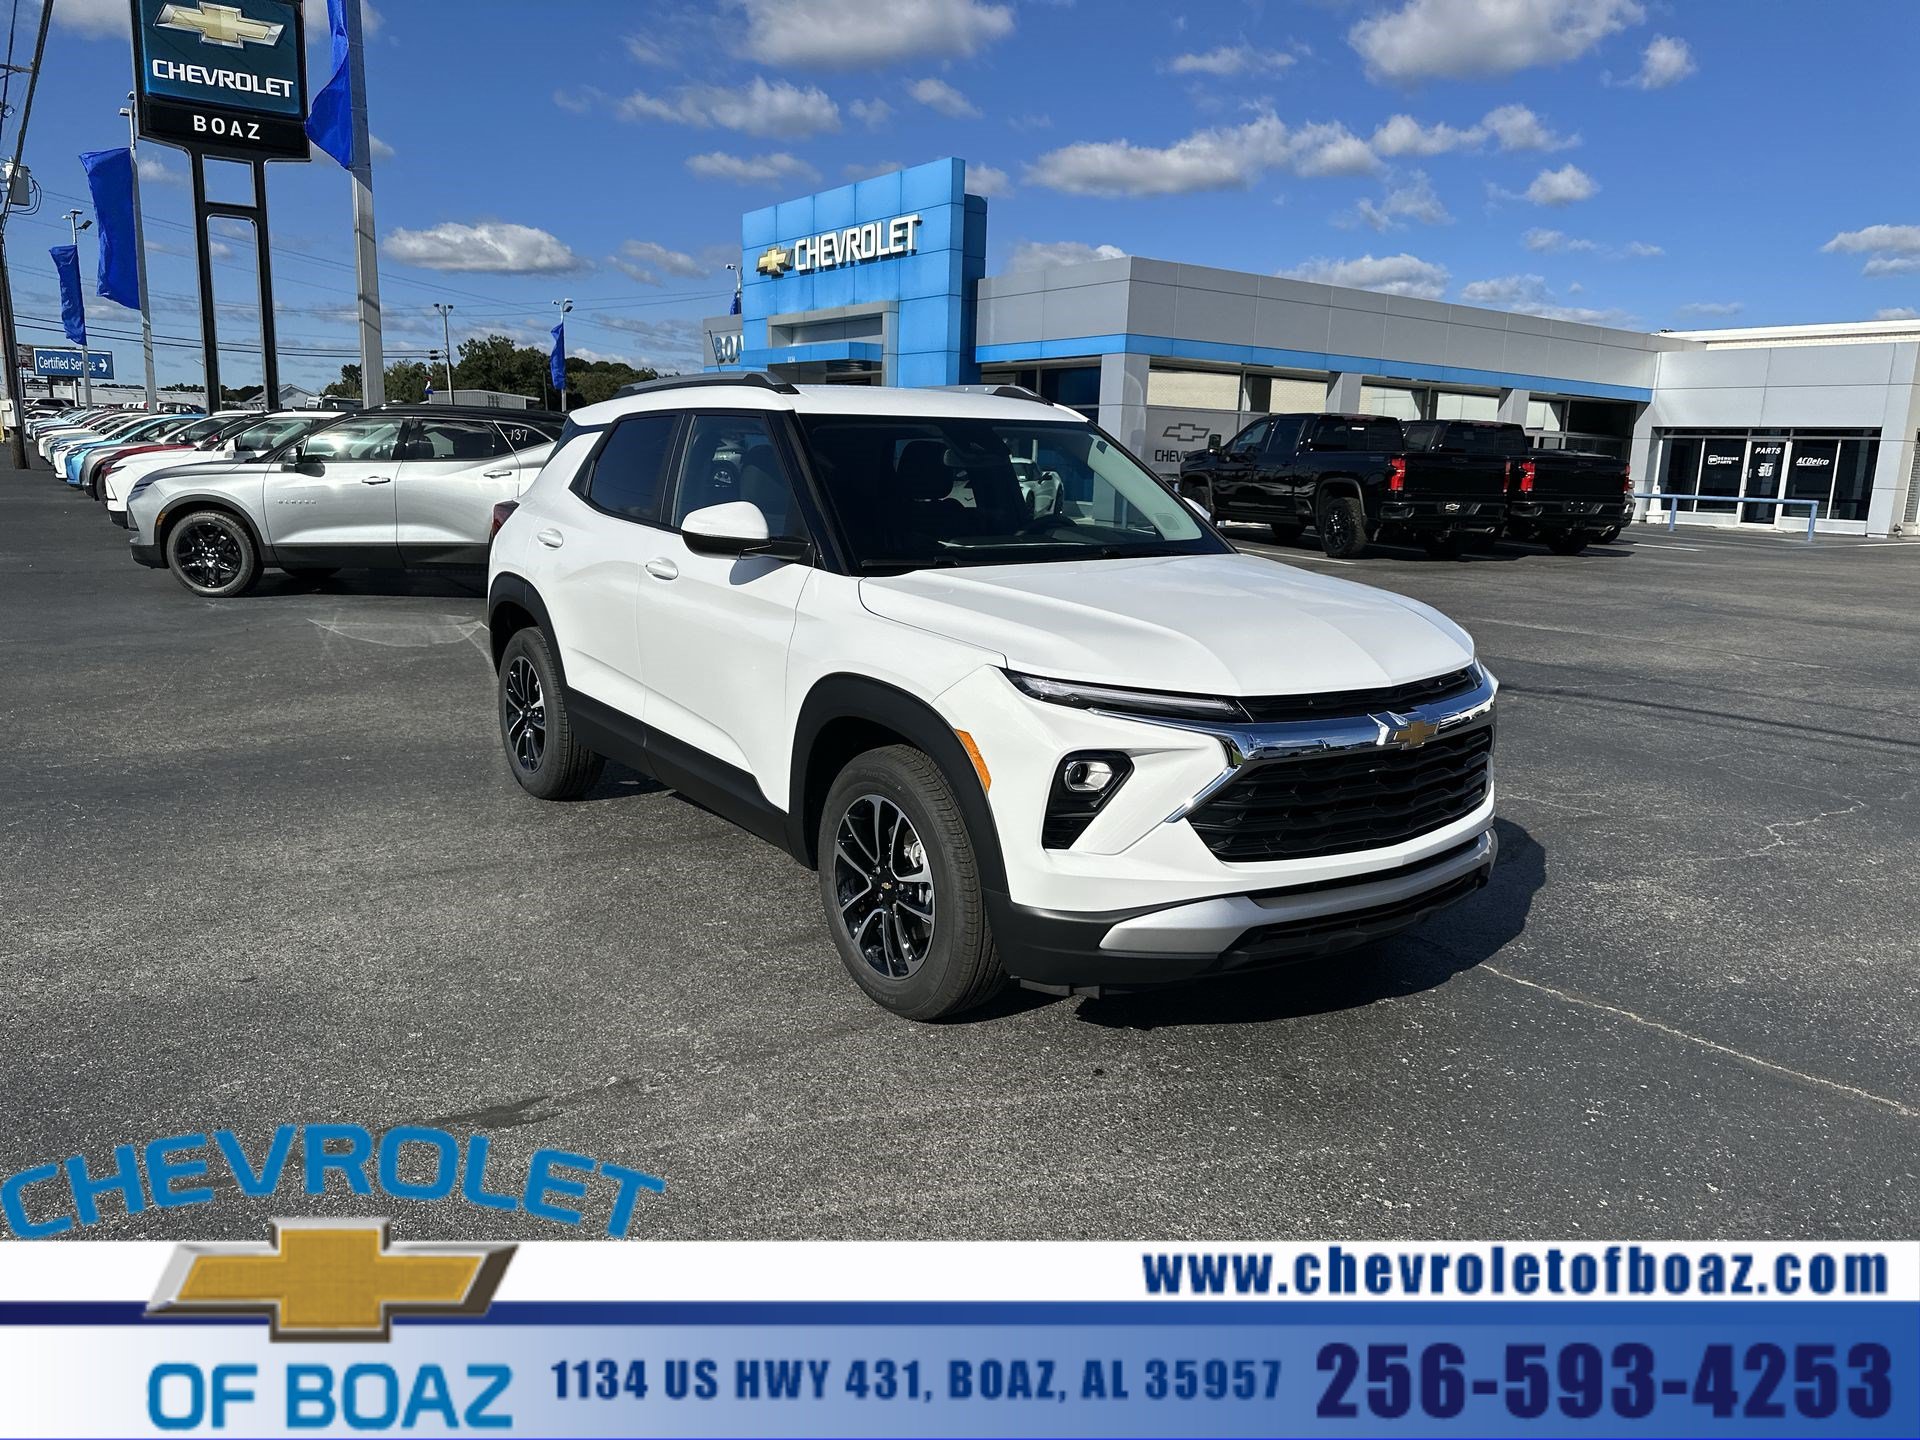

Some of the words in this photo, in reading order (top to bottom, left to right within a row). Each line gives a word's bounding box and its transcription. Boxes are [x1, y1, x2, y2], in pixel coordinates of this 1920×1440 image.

[152, 59, 294, 98] CHEVROLET
[193, 114, 261, 140] BOAZ
[794, 214, 919, 271] CHEVROLET
[38, 356, 69, 370] Certified
[70, 358, 97, 371] Serce
[510, 428, 528, 442] 137
[1154, 449, 1186, 462] CHEV
[1796, 457, 1830, 466] ACDelco
